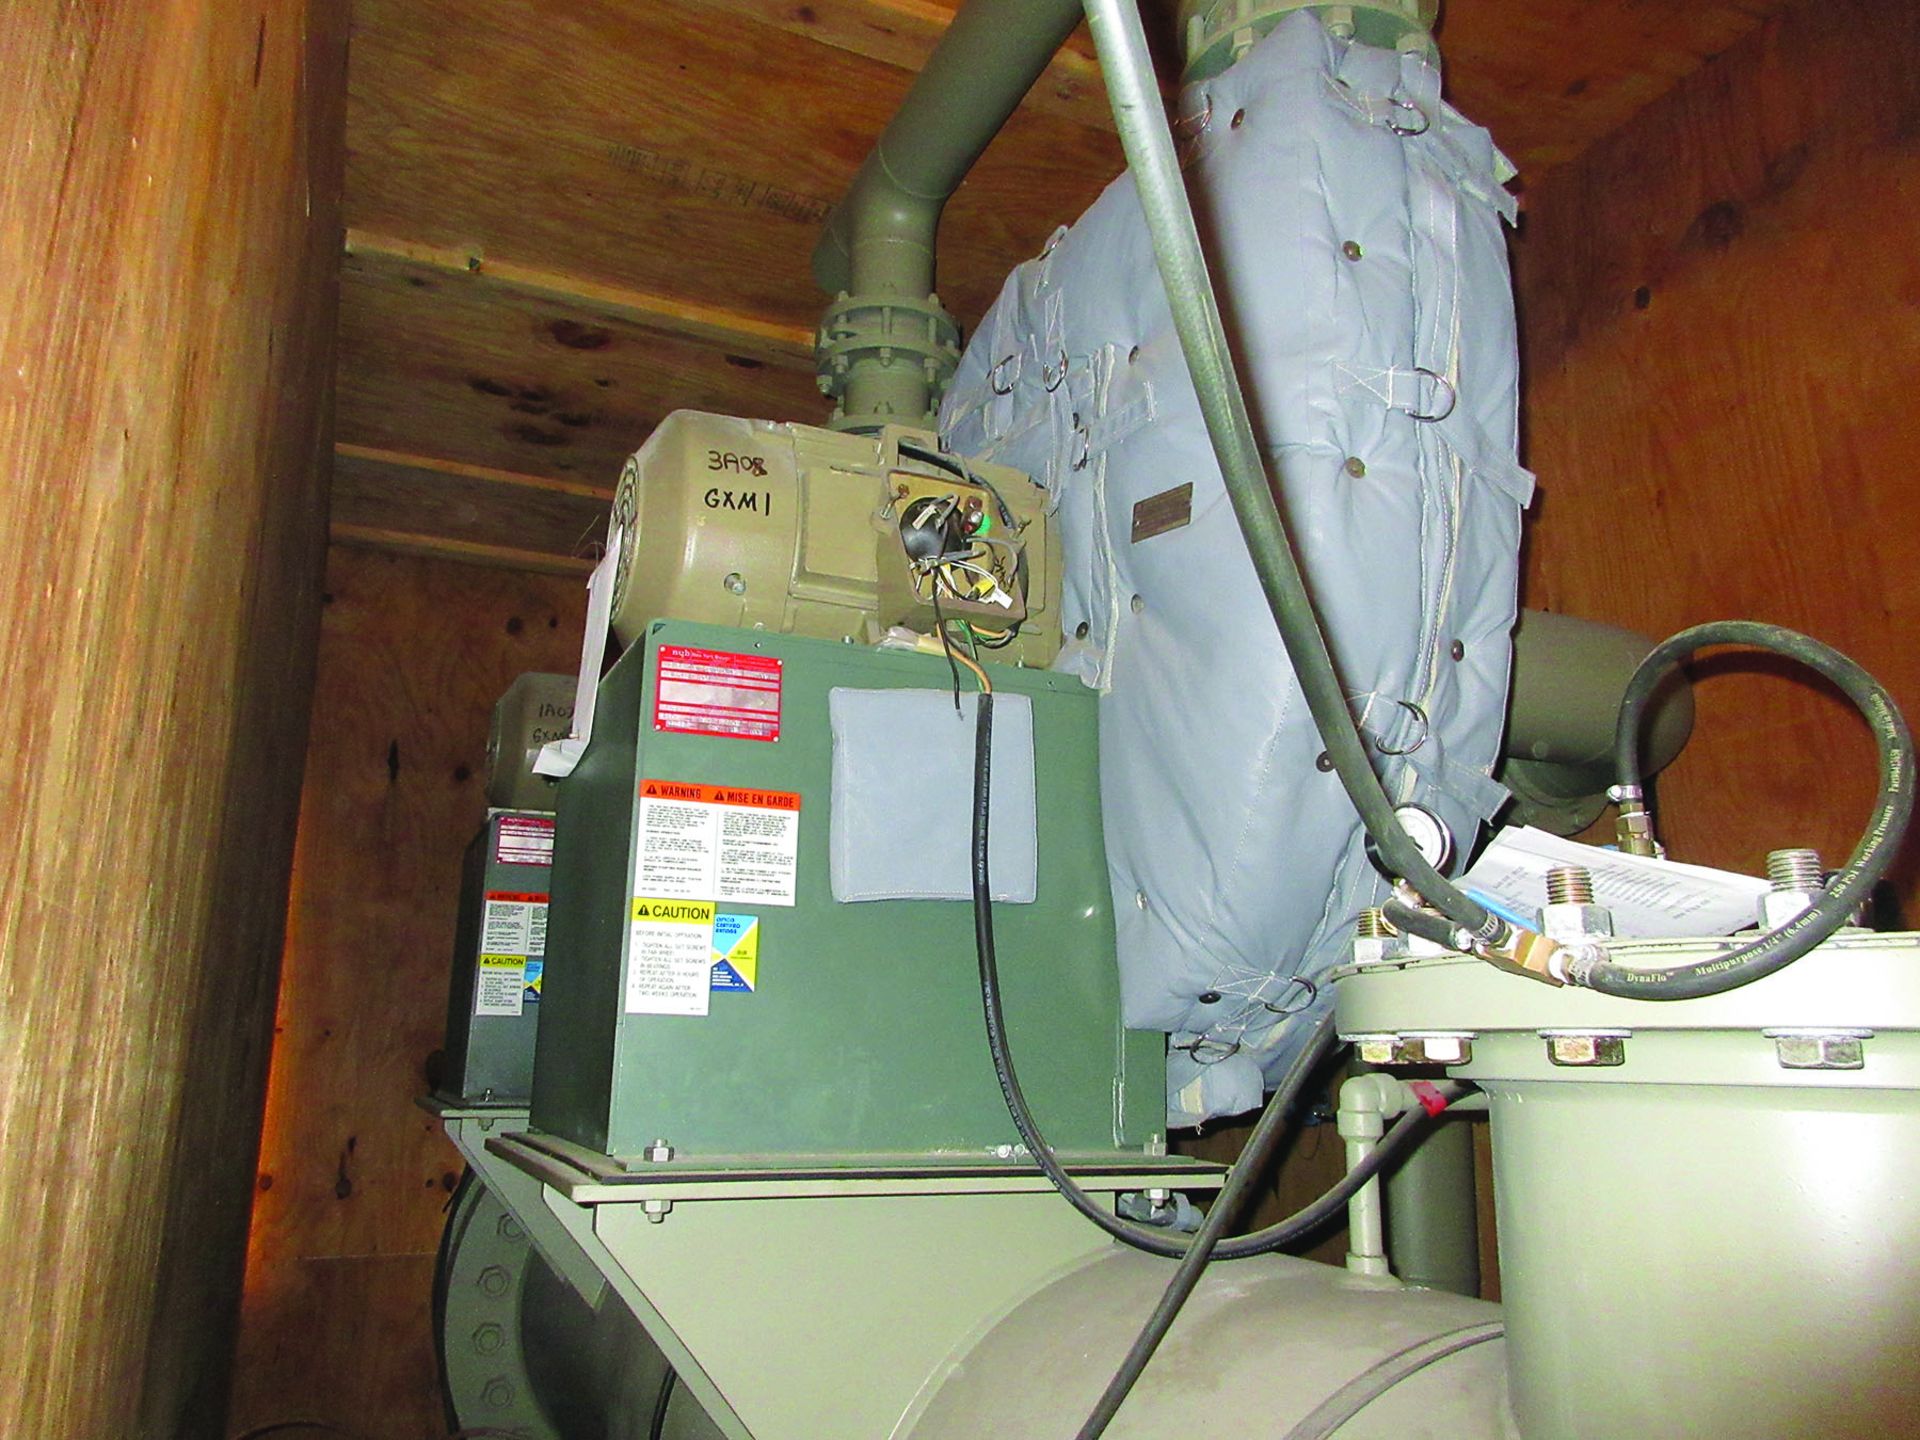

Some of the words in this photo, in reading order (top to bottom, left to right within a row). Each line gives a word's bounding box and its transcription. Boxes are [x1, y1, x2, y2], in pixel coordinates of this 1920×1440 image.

[660, 785, 701, 799] WARNING
[727, 792, 749, 804] MISE
[752, 795, 764, 805] EN
[767, 796, 794, 808] GARDE
[1695, 948, 1763, 977] Multipurpose
[1783, 908, 1823, 938] (6.4mm)
[1829, 883, 1847, 899] 250
[1841, 869, 1860, 885] PSI
[1854, 836, 1884, 868] Working
[1872, 805, 1895, 837] Pressure
[652, 904, 710, 920] CAUTION
[491, 957, 524, 965] CAUTION
